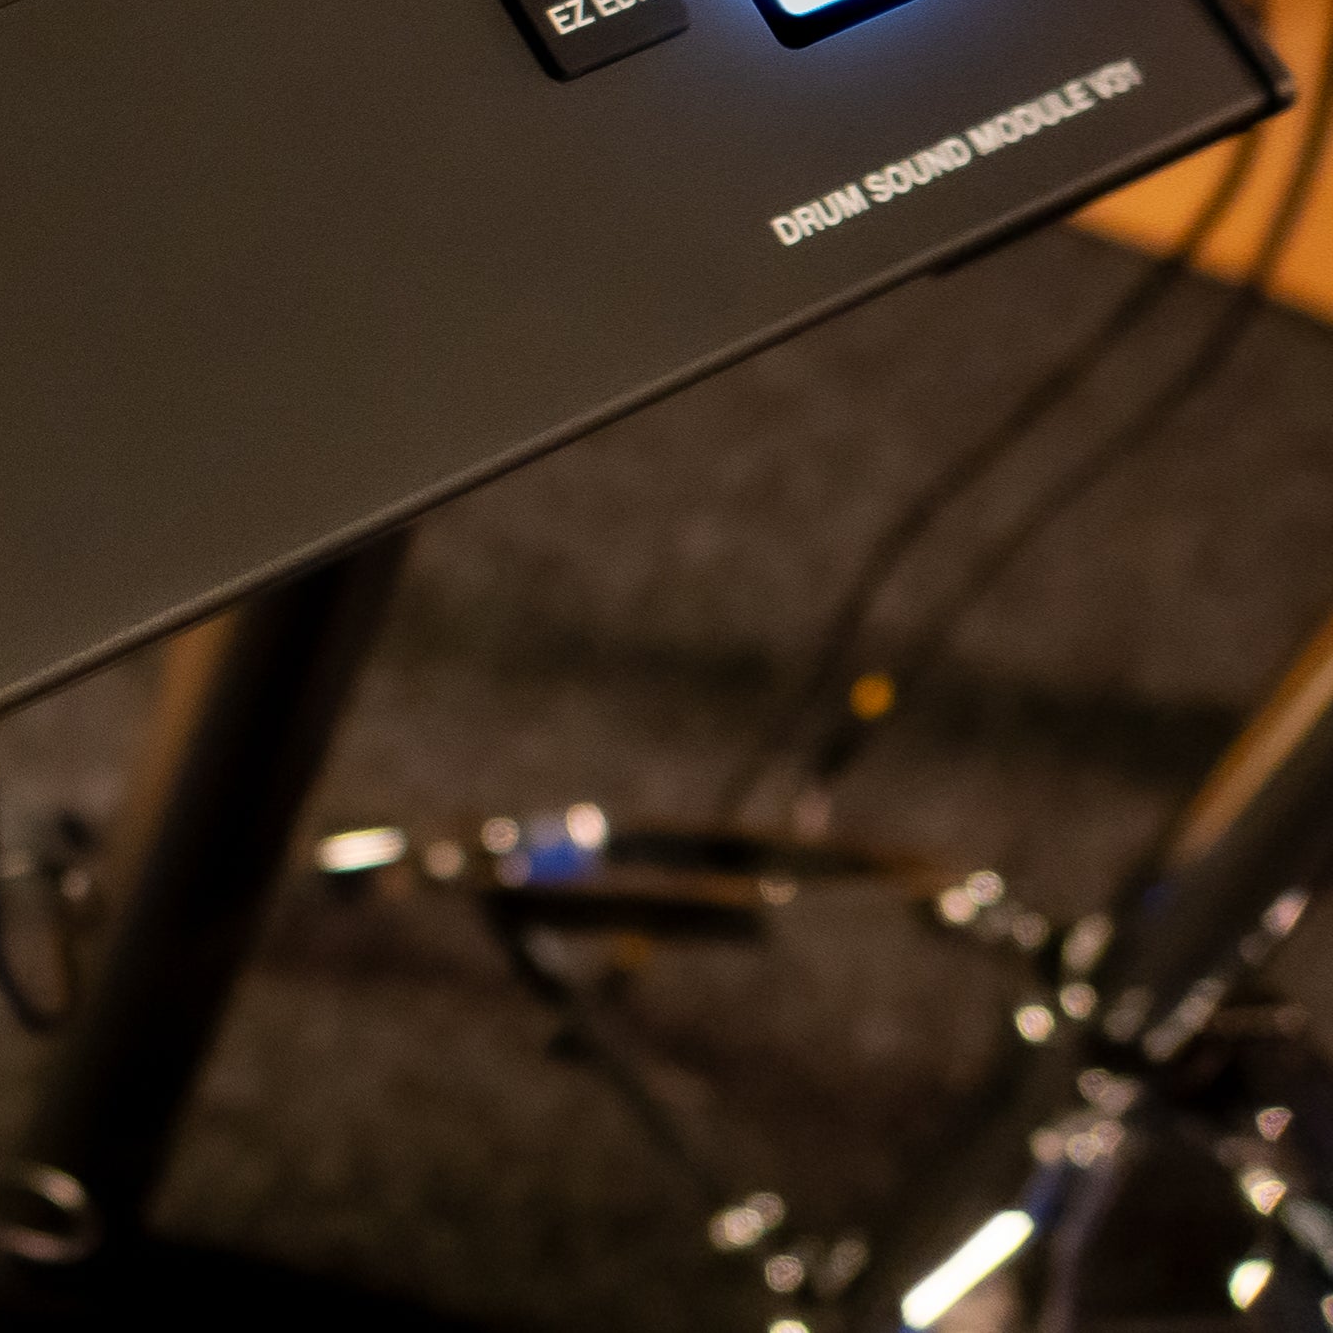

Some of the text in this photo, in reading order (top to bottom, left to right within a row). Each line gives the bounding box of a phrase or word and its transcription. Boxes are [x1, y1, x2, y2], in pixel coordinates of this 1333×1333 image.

[546, 0, 595, 36] EZ
[770, 193, 869, 247] DRUM
[865, 137, 972, 202] SOUND
[968, 79, 1097, 155] MODULE
